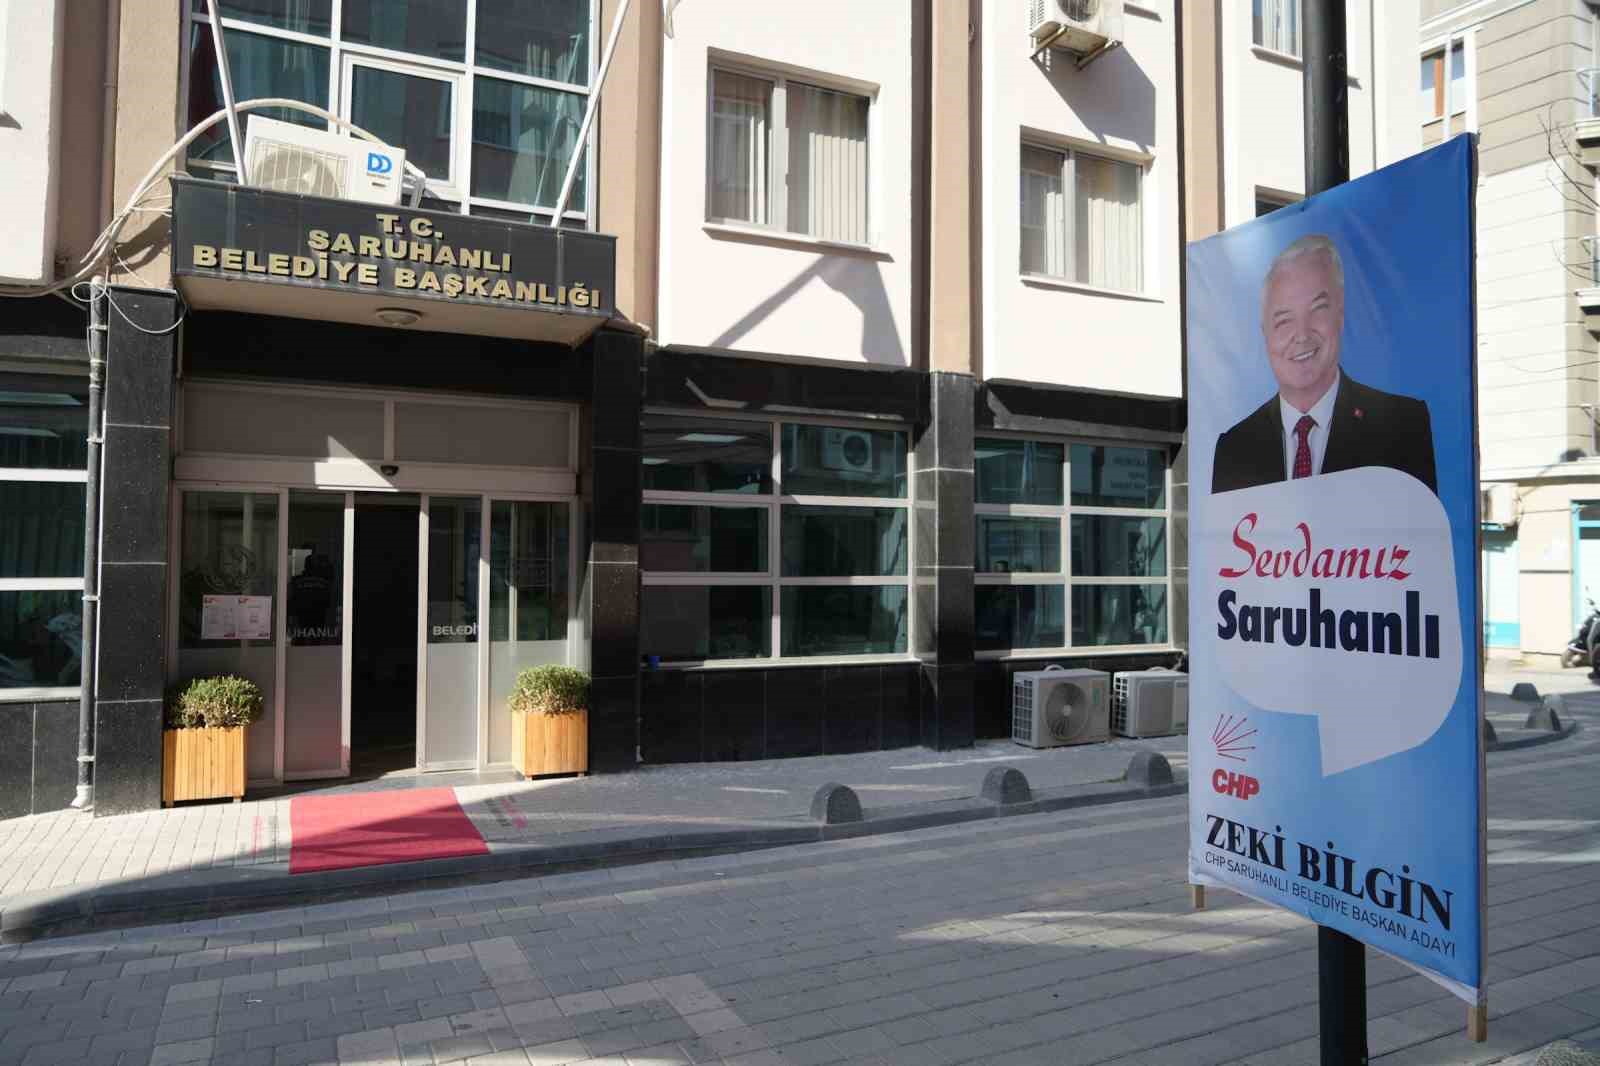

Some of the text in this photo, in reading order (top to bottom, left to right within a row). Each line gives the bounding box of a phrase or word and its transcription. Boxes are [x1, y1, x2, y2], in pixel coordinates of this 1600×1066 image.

[192, 244, 601, 309] BELEDİYE BAŞKANLIĞI
[308, 230, 513, 273] SARUHANLI
[1218, 588, 1441, 659] Saruhanlı
[1212, 768, 1260, 801] CHP
[1205, 851, 1226, 871] CHP
[1226, 860, 1289, 893] SARUHANLI
[1292, 882, 1348, 917] BELEDİYE
[1409, 929, 1456, 958] ADAYI
[1206, 813, 1455, 931] ZEKİ BİLGİN
